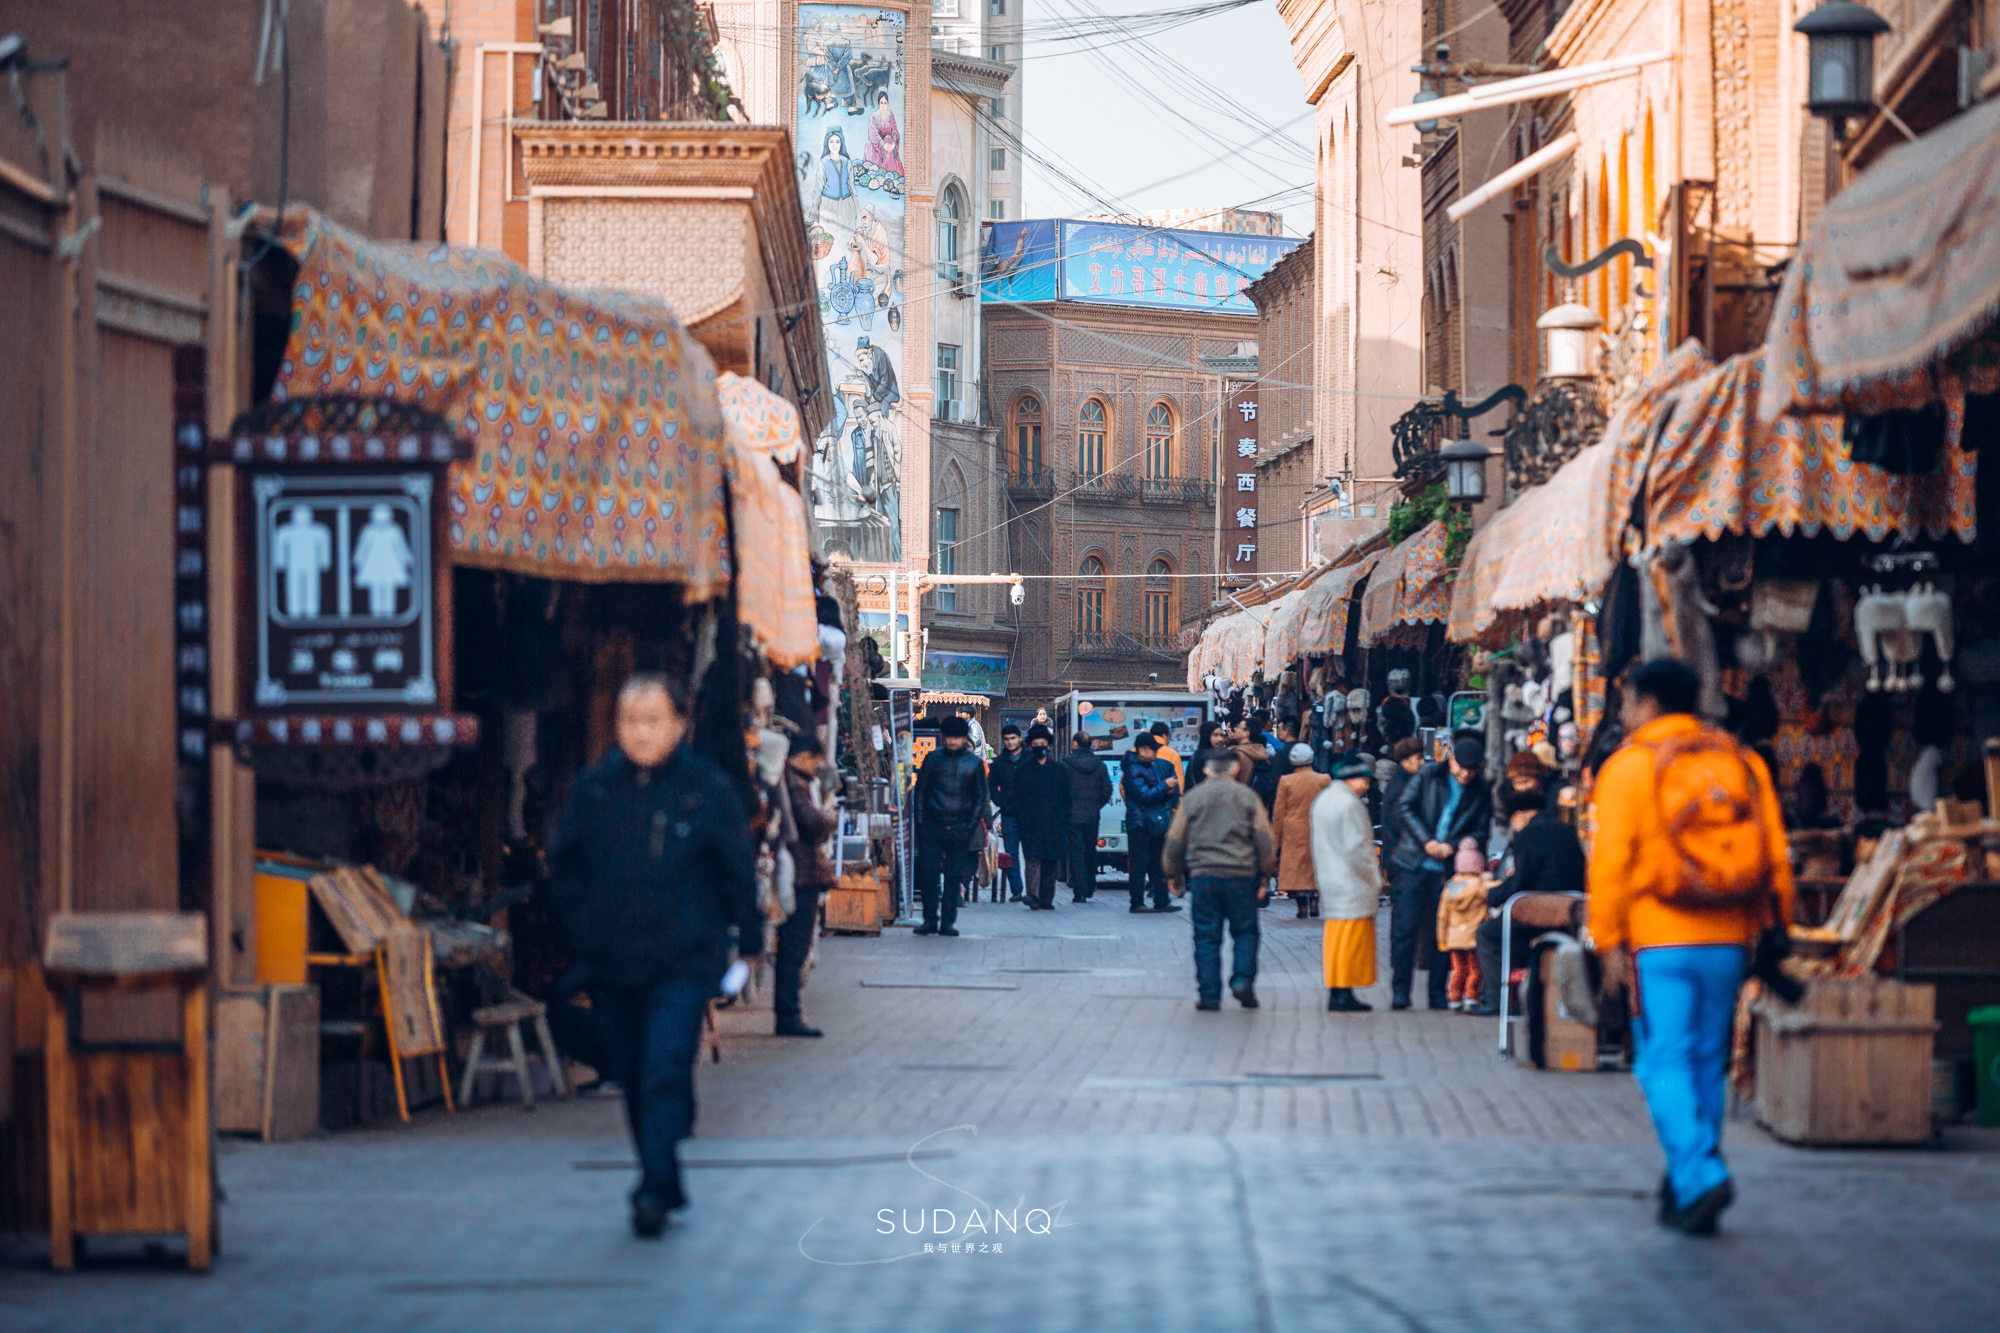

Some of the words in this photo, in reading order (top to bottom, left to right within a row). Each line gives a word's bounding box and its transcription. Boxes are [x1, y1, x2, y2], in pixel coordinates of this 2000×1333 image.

[1235, 401, 1258, 562] 节奏西餐厅
